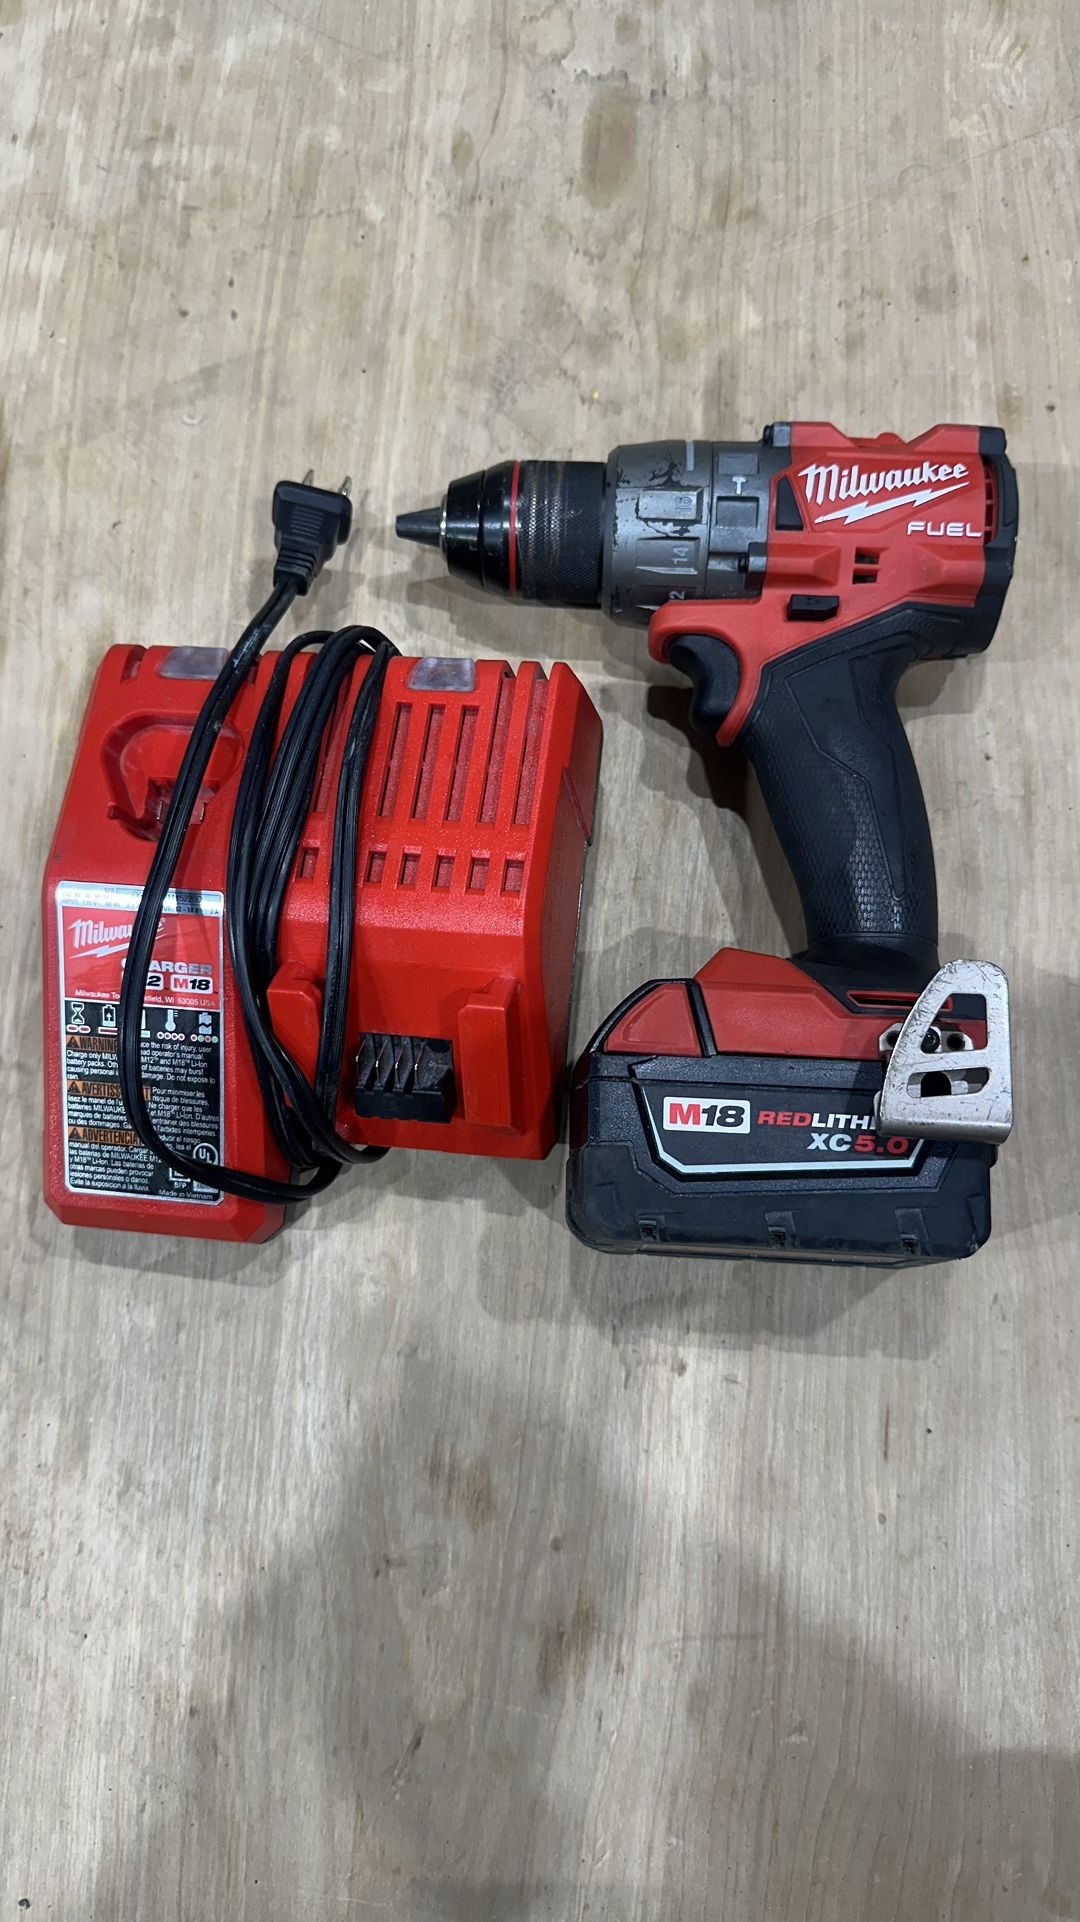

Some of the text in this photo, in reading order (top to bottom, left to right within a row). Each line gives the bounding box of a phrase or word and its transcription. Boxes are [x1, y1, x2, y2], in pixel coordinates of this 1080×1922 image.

[798, 461, 969, 506] Milwaukee
[906, 522, 981, 538] FUEL
[173, 977, 211, 991] M18
[67, 1050, 87, 1060] Charge
[89, 1053, 101, 1062] only
[669, 1102, 746, 1128] M18
[807, 1133, 909, 1155] XC5.0
[186, 1192, 214, 1200] Vietnam
